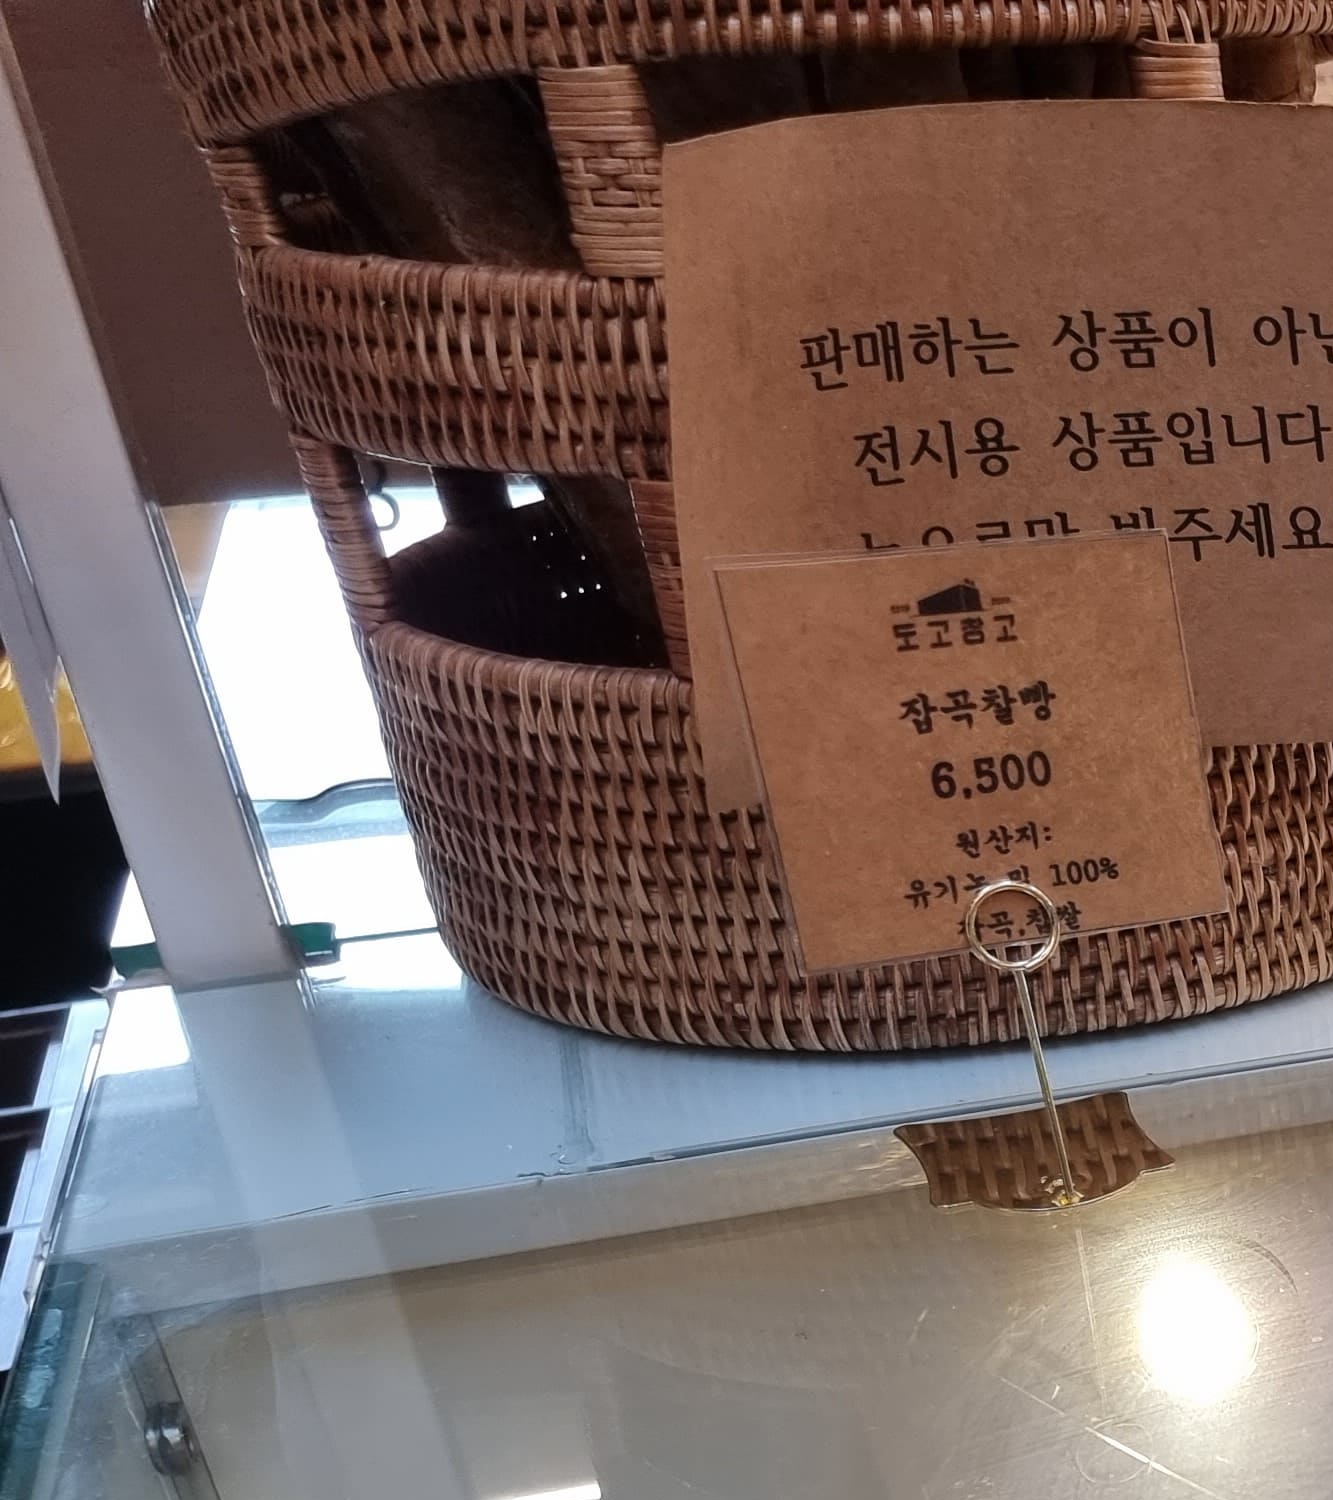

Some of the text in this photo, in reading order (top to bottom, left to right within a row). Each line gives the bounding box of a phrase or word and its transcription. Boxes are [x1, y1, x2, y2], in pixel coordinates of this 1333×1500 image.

[799, 316, 1019, 392] 판매하는
[1051, 308, 1218, 372] 상품이
[853, 404, 1332, 488] 전시용 상품입니다
[900, 680, 1056, 734] 잡곡찰빵
[931, 751, 1051, 799] 6,500
[956, 822, 1053, 857] 원산지:
[1049, 857, 1119, 887] 100%
